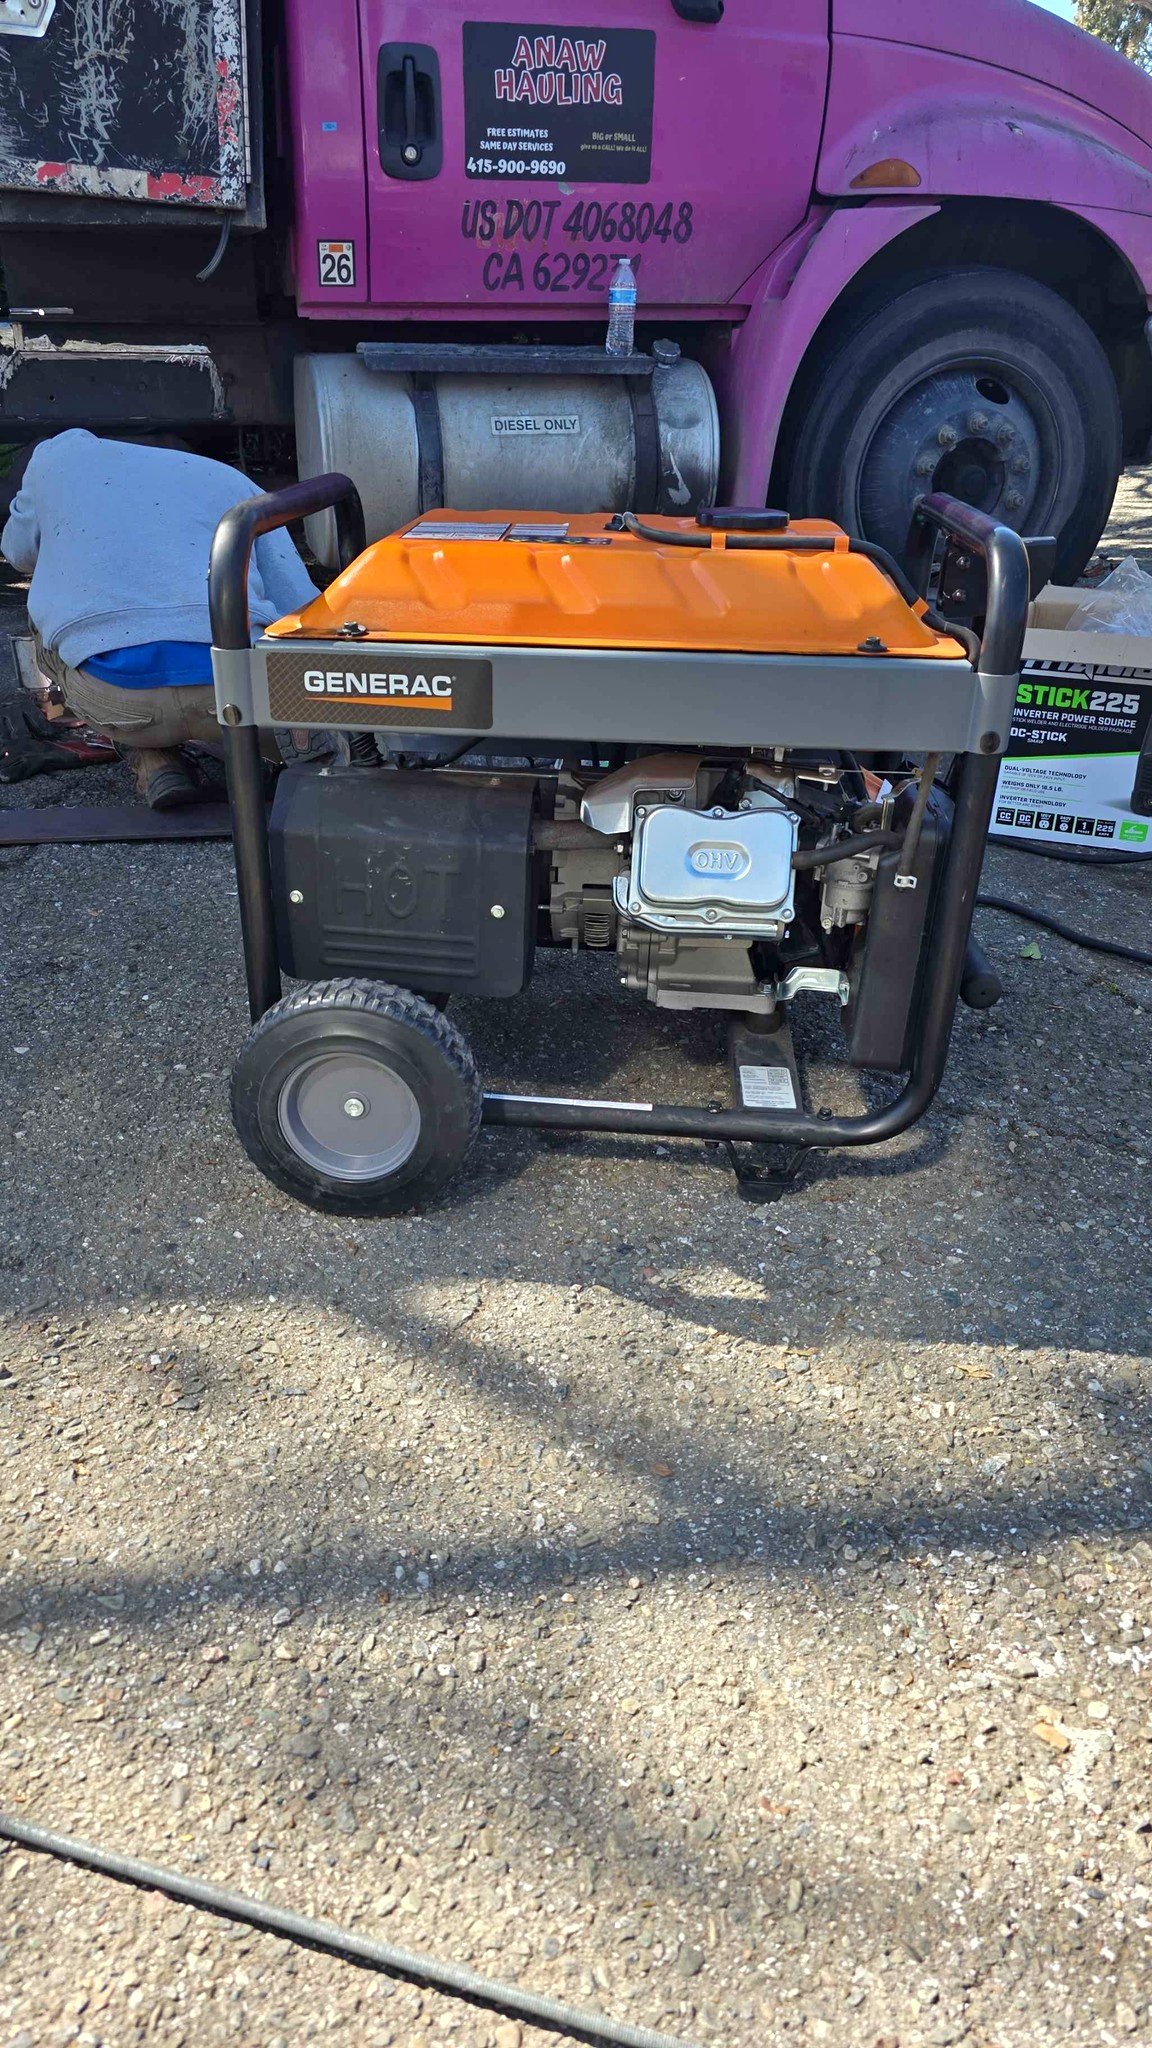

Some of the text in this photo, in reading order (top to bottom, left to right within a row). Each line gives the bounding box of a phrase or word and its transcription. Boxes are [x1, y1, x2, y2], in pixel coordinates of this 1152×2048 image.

[512, 36, 606, 72] ANAW
[495, 69, 622, 105] HAULING
[487, 128, 548, 138] FREE ESTIMATES
[592, 131, 604, 141] BIG
[614, 132, 636, 142] SMALL
[480, 140, 553, 152] SAME DAY SERVICES
[467, 157, 566, 175] 415-900-9690
[461, 199, 693, 244] US DOT 4068048
[322, 253, 351, 283] 26
[482, 252, 524, 291] CA
[495, 419, 577, 431] DIESEL ONLY
[304, 670, 452, 696] GENERAC
[1013, 708, 1137, 729] INVERTER POWER SOURCE
[1027, 718, 1048, 726] WELDER
[1010, 727, 1068, 742] DC-STICK
[1004, 765, 1087, 780] DUAL-VOLTAGE TECHNOLOGY
[1002, 780, 1024, 788] WEIGHS
[999, 795, 1067, 808] INVERTER TECHNOLOGY
[1000, 812, 1012, 820] CC
[1019, 814, 1031, 822] DC
[1096, 824, 1114, 832] 225
[696, 851, 739, 871] OHV
[334, 857, 461, 920] HOT
